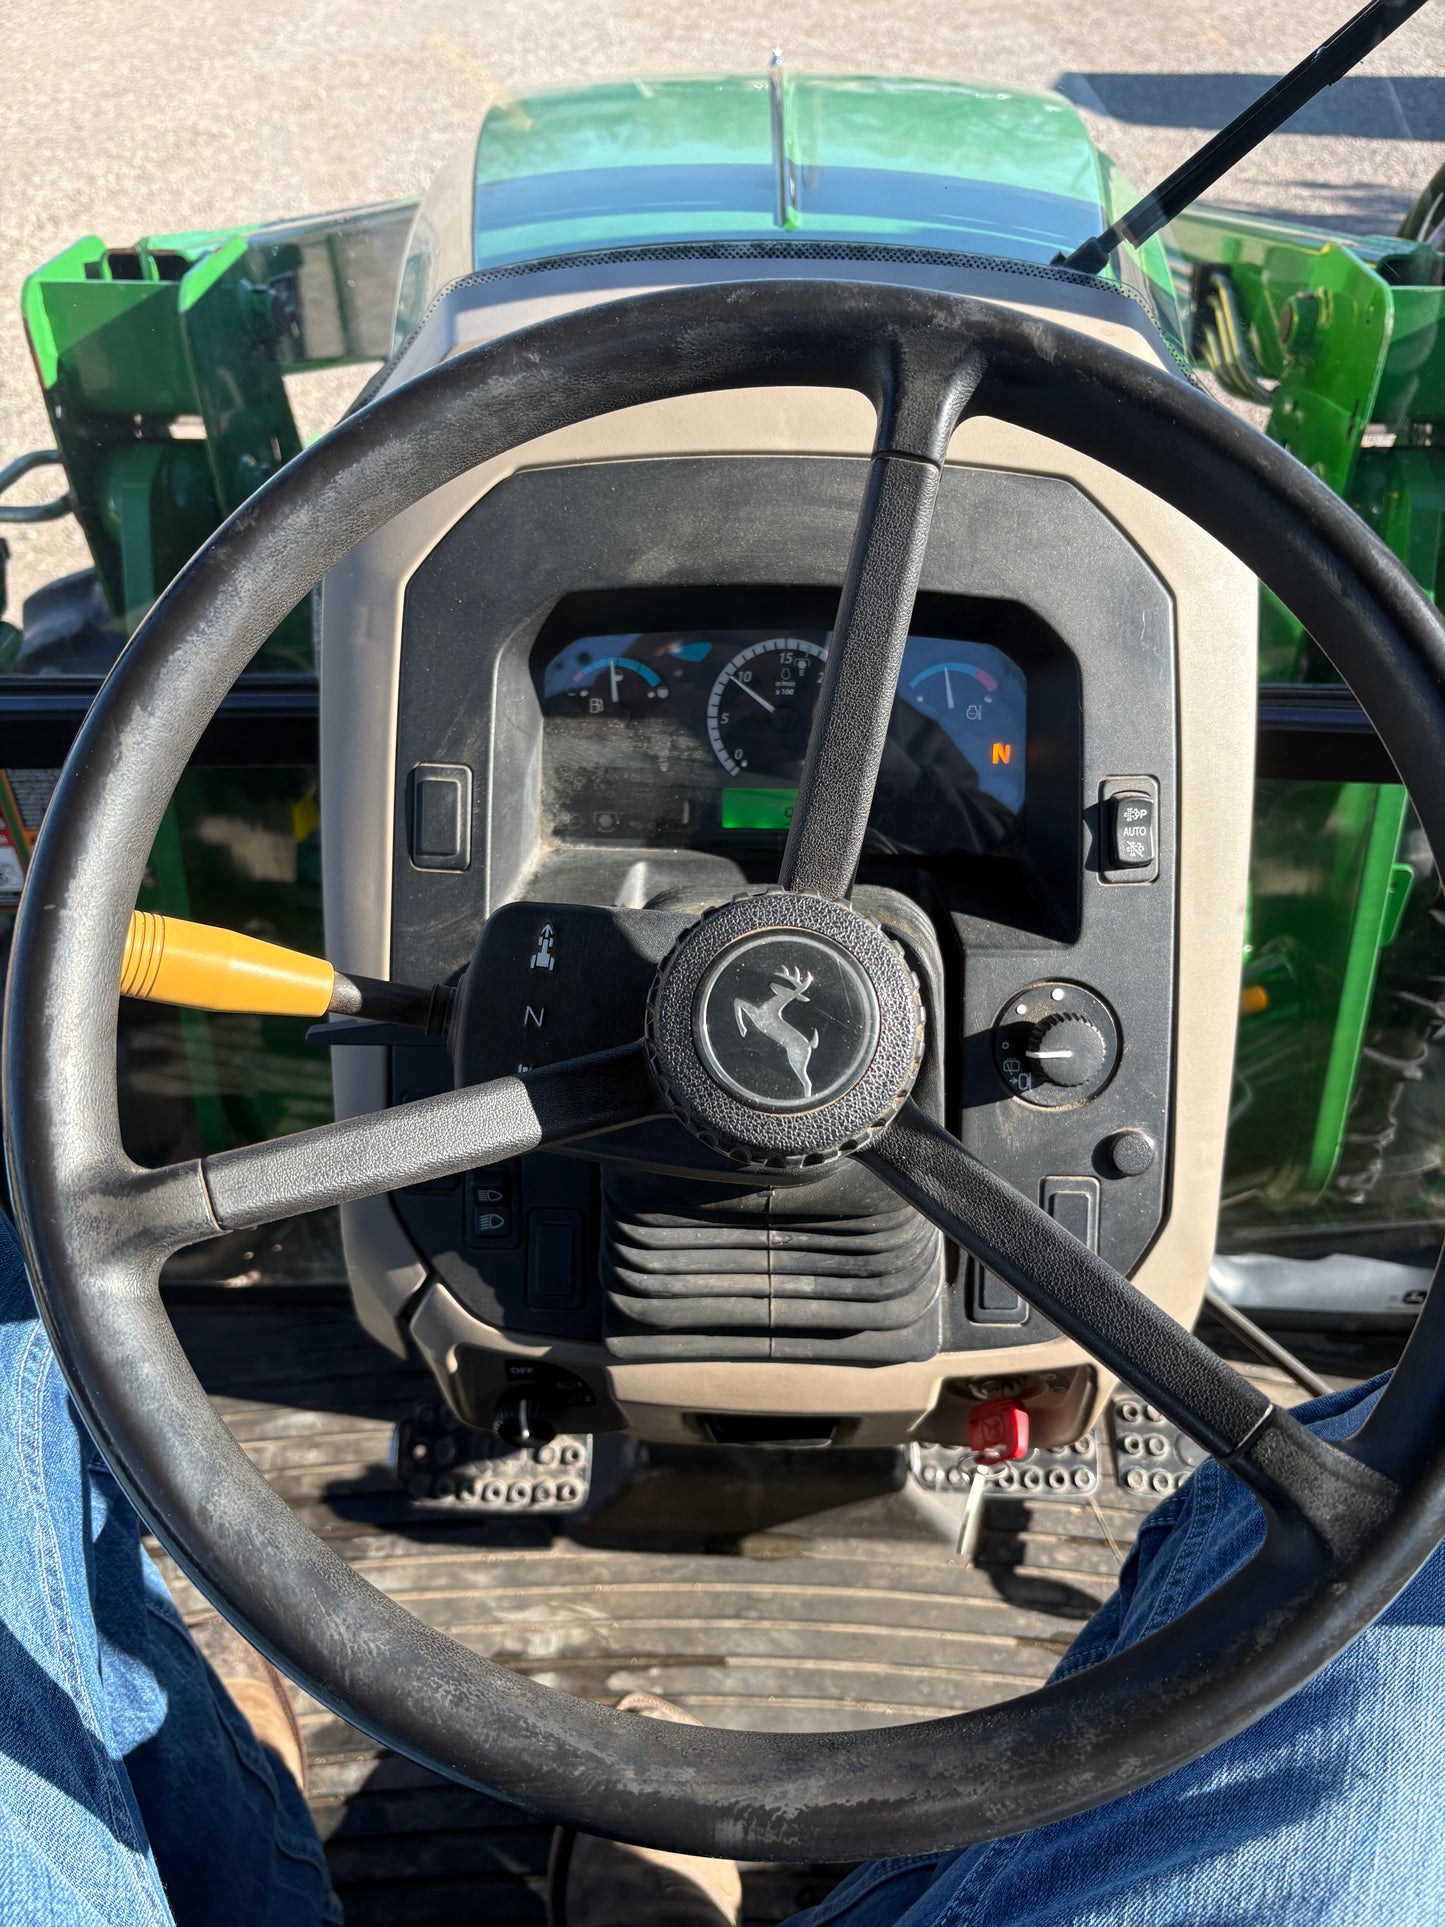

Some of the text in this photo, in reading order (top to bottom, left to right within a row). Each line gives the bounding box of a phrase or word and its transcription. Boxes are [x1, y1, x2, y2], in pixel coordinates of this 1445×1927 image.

[780, 652, 794, 665] 15
[738, 671, 752, 683] 10
[781, 688, 795, 696] 100
[720, 712, 730, 724] 5
[733, 748, 743, 760] 0
[991, 742, 1011, 765] N
[1123, 826, 1146, 837] AUTO
[523, 1005, 544, 1028] N
